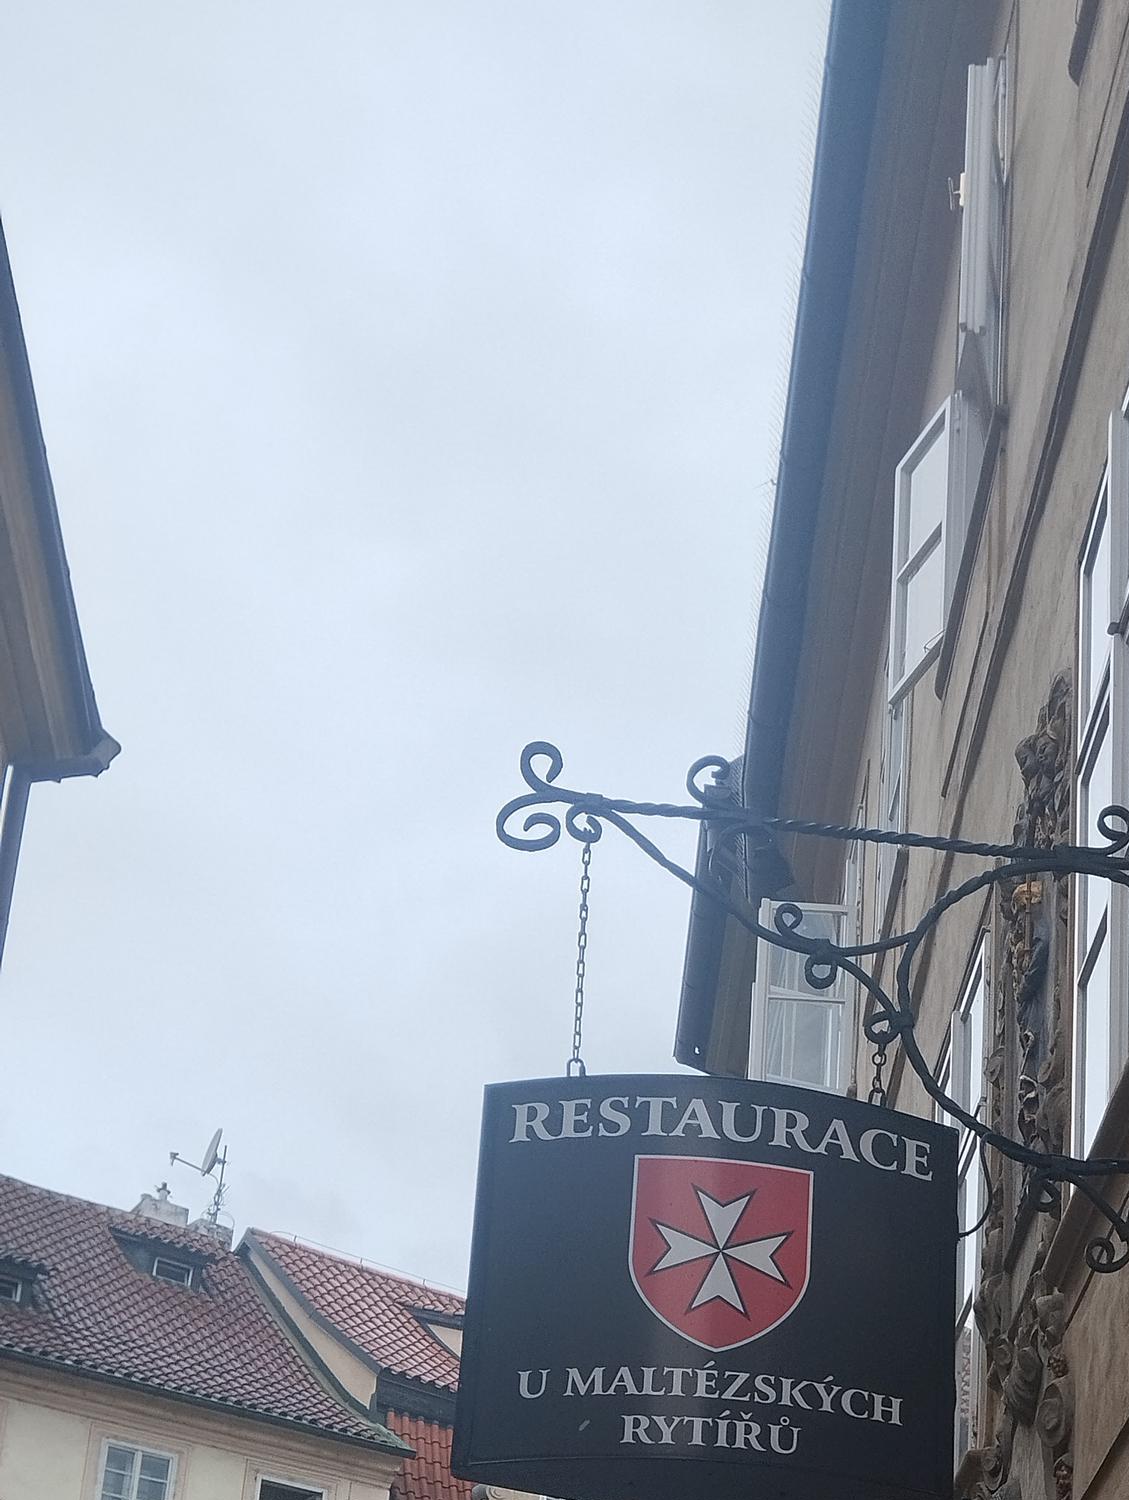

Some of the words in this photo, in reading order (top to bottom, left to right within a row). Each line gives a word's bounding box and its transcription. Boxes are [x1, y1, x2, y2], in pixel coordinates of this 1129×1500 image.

[508, 1096, 934, 1182] RESTAURACE
[517, 1369, 551, 1400] U
[563, 1361, 904, 1426] MALTÉZSKÝCH
[619, 1408, 803, 1455] RYTÍŘŮ
